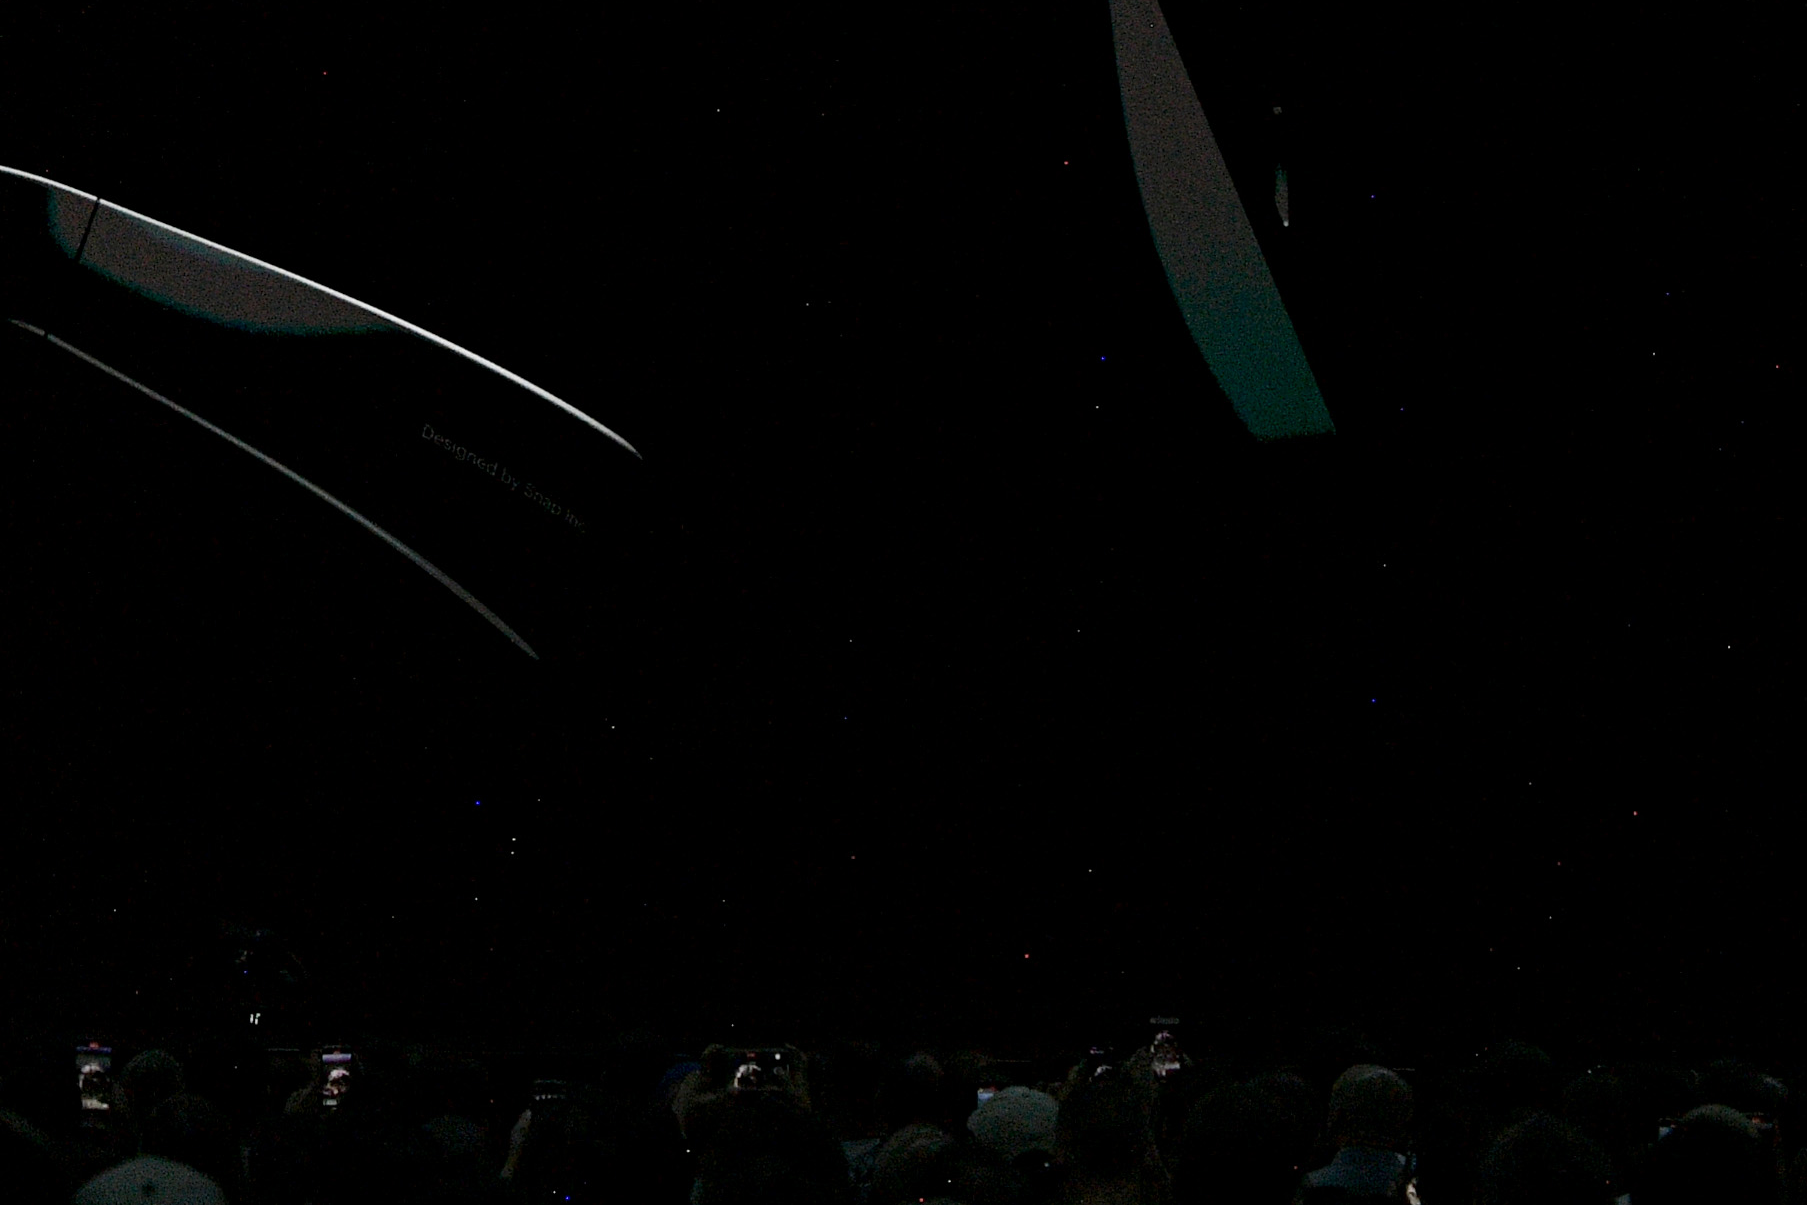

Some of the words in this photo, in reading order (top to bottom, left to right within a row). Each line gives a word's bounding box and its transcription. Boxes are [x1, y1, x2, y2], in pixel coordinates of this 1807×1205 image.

[420, 422, 498, 477] Designed
[500, 467, 521, 492] by
[523, 482, 562, 516] Snap
